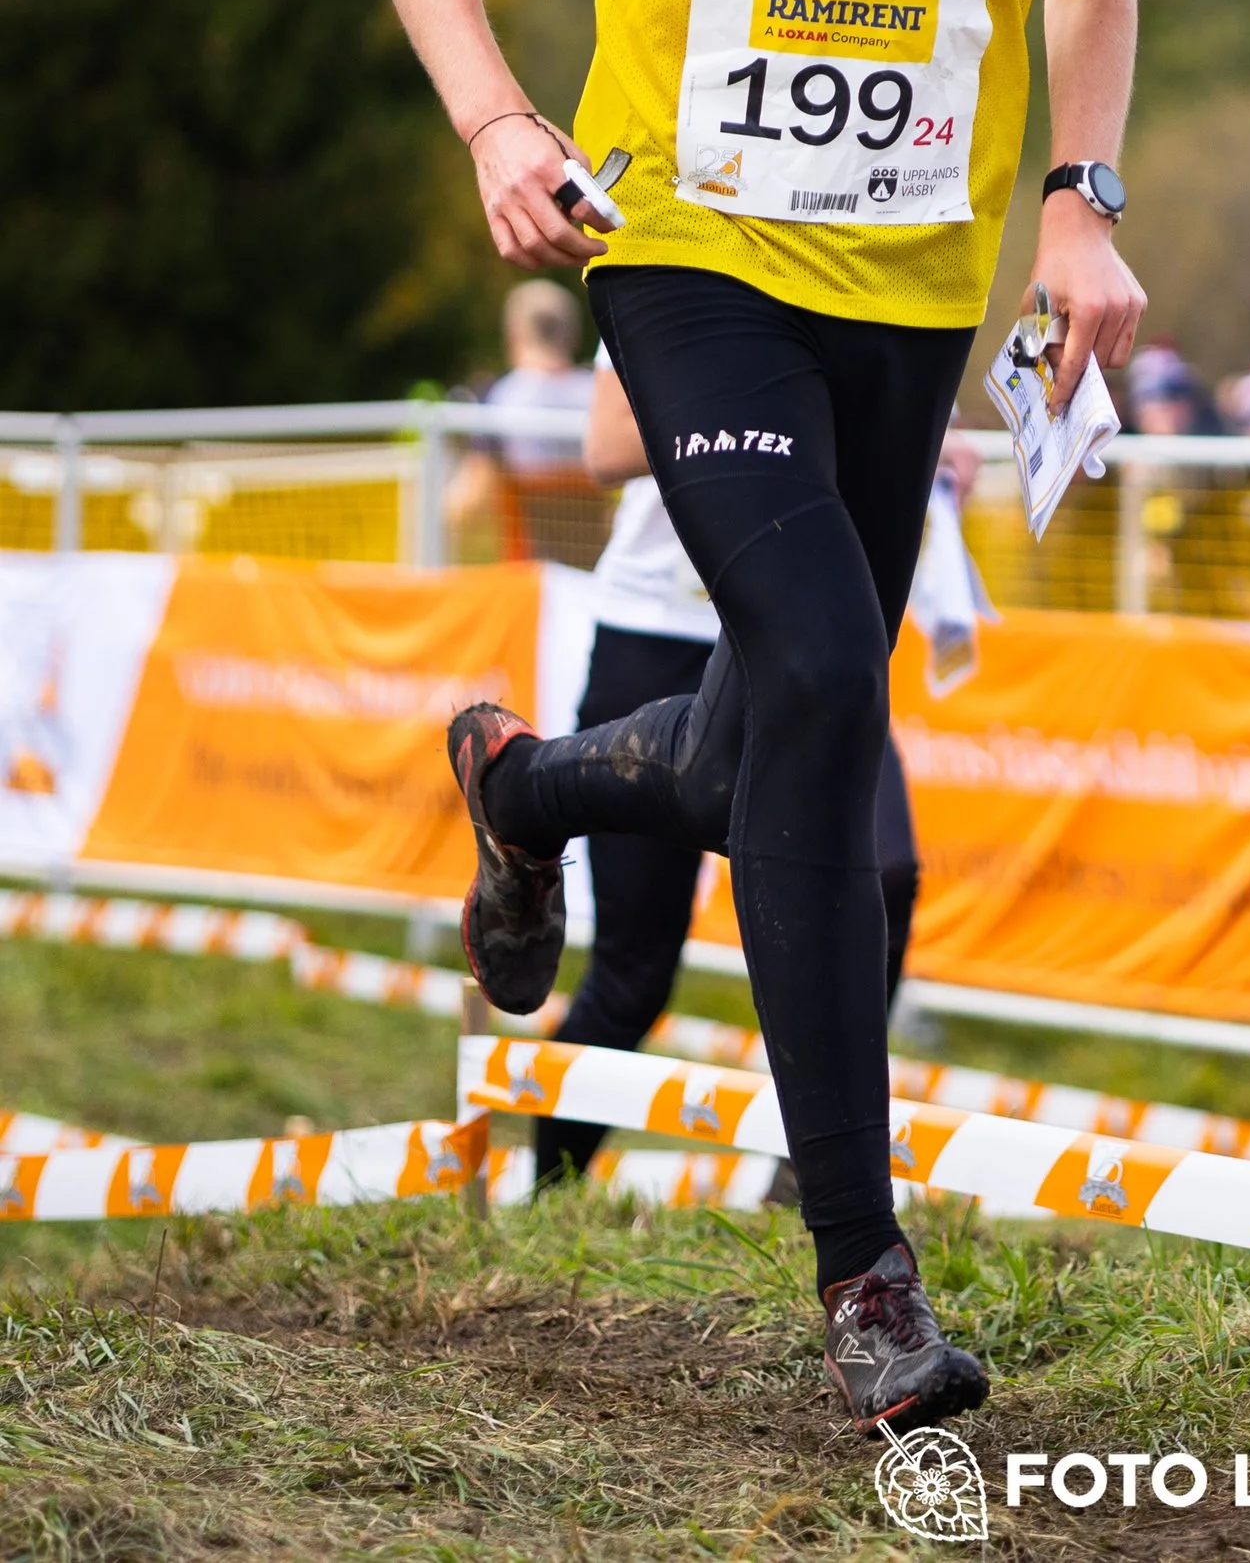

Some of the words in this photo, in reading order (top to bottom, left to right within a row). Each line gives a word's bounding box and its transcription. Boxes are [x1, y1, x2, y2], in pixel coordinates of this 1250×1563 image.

[765, 26, 774, 36] A
[778, 27, 828, 42] LOXAM
[831, 31, 890, 49] Company
[719, 56, 913, 150] 199
[913, 116, 954, 146] 24
[903, 166, 960, 182] UPPLANDS
[901, 182, 937, 197] VÄSBY
